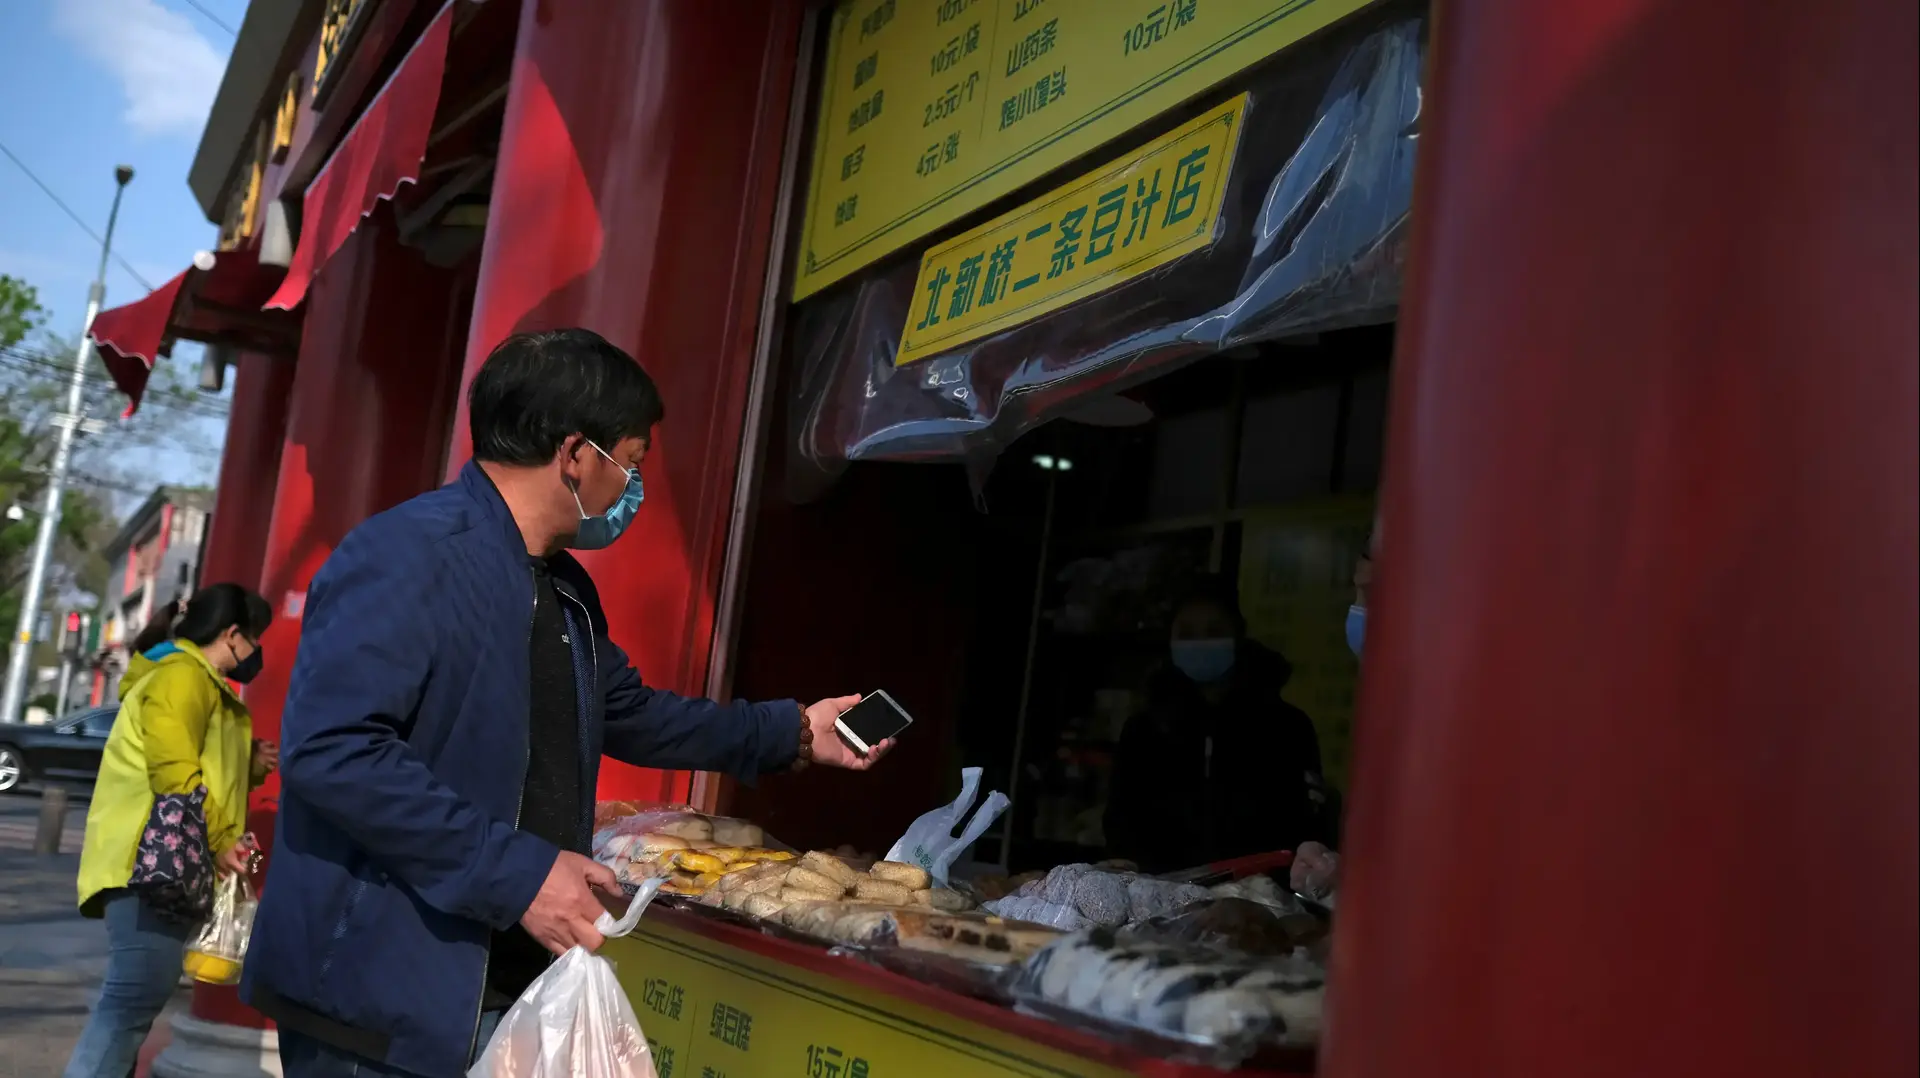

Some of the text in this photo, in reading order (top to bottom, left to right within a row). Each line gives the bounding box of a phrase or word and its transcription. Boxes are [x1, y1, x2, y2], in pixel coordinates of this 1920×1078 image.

[931, 21, 981, 77] 10元/袋
[1006, 17, 1059, 77] 山药条
[1123, 0, 1197, 57] 10元/袋
[923, 71, 979, 128] 2.5元/个
[999, 65, 1067, 131] 烤小馒头
[916, 131, 961, 178] 4元/张
[916, 145, 1211, 331] 北新桥二条豆汁店
[642, 978, 685, 1021] 12元/袋
[709, 1002, 752, 1051] 绿豆糕
